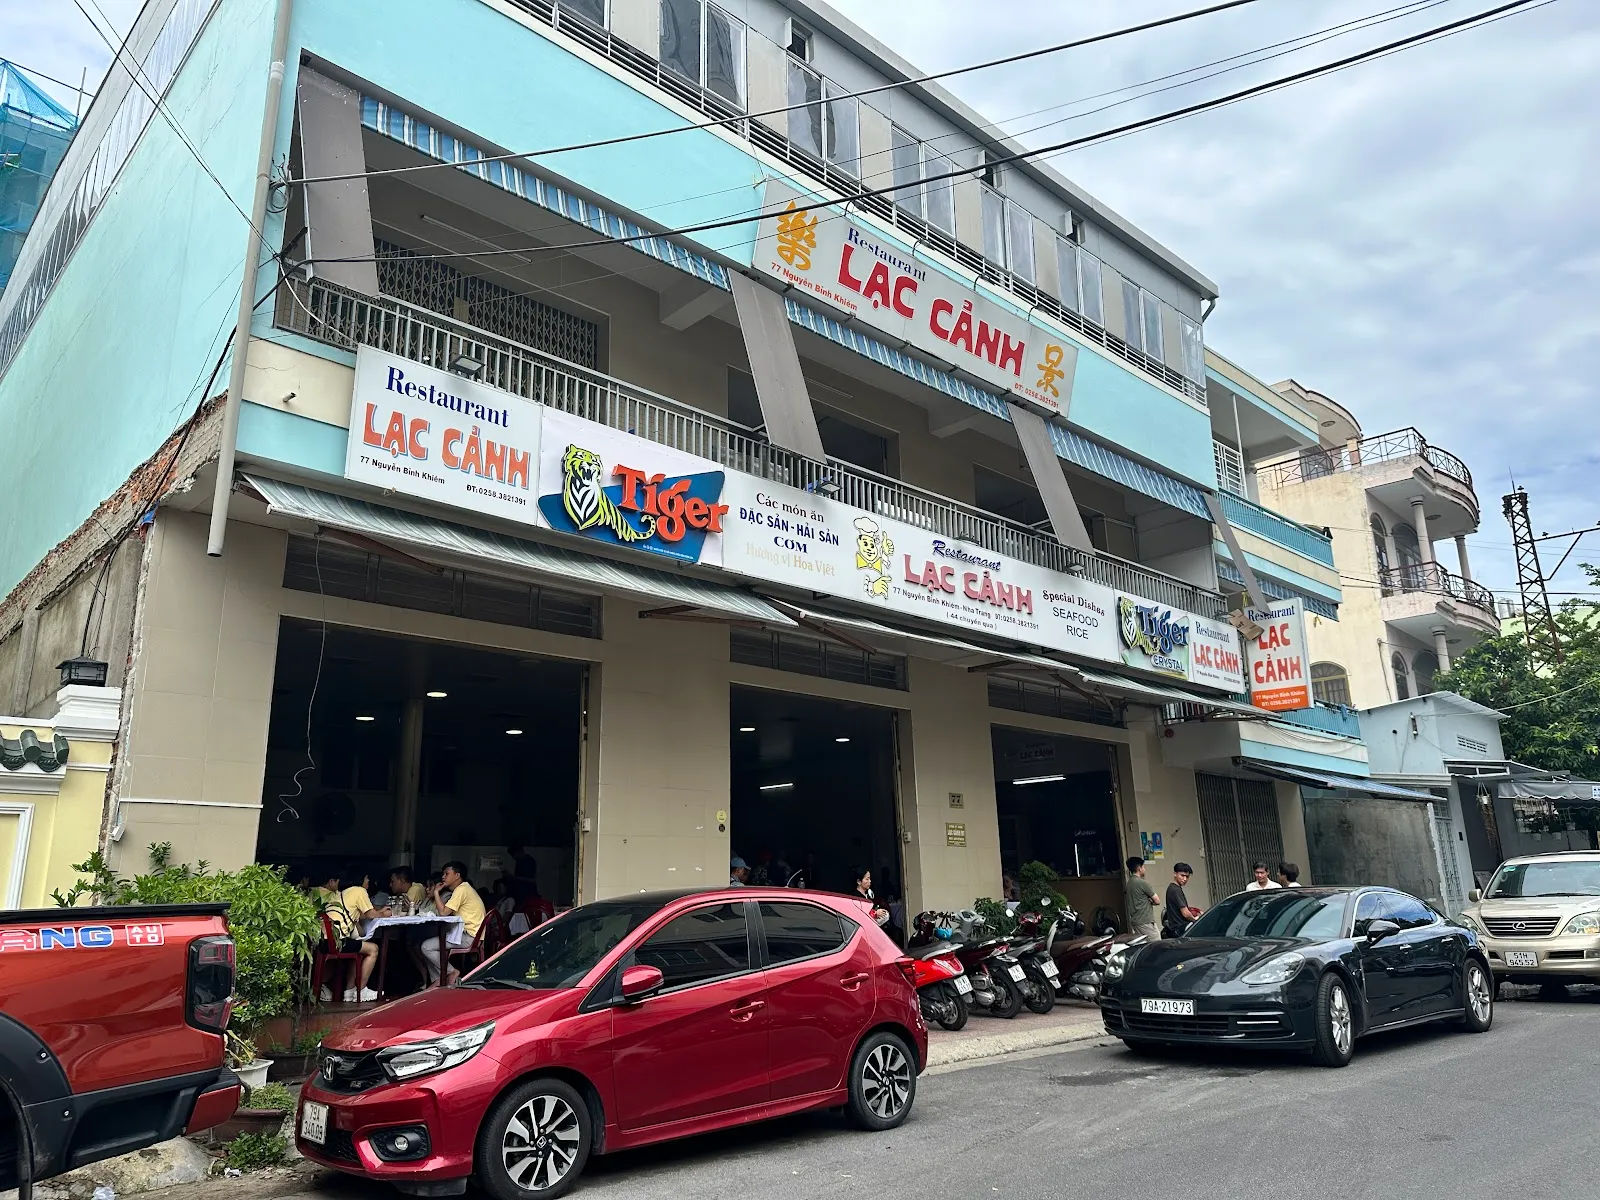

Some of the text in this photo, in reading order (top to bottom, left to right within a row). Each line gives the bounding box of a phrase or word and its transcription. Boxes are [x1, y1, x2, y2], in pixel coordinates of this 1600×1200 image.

[771, 262, 781, 272] 77
[848, 227, 926, 282] Restaurant
[837, 243, 1025, 378] LẠC CẢNH
[386, 366, 510, 428] Restaurant
[360, 455, 370, 464] 77
[363, 402, 531, 490] LẠC CẢNH
[611, 463, 730, 542] Tiger
[756, 492, 824, 523] Các món ăn
[739, 507, 763, 525] ĐẶC
[818, 528, 839, 546] SẢN
[773, 536, 808, 554] CƠM
[931, 540, 1001, 572] Restaurant
[893, 586, 900, 594] 77
[904, 554, 1033, 615] LẠC CẢNH
[1042, 590, 1105, 617] Special Dishes
[1052, 606, 1099, 628] SEAFOOD
[1066, 625, 1089, 640] RICE
[1134, 604, 1189, 654] Tiger
[1195, 621, 1230, 643] Restaurant
[1258, 623, 1291, 652] LẠC
[1153, 654, 1185, 671] CRYSTAL
[1193, 642, 1240, 675] LẠC CẢNH
[1254, 653, 1302, 684] CẢNH
